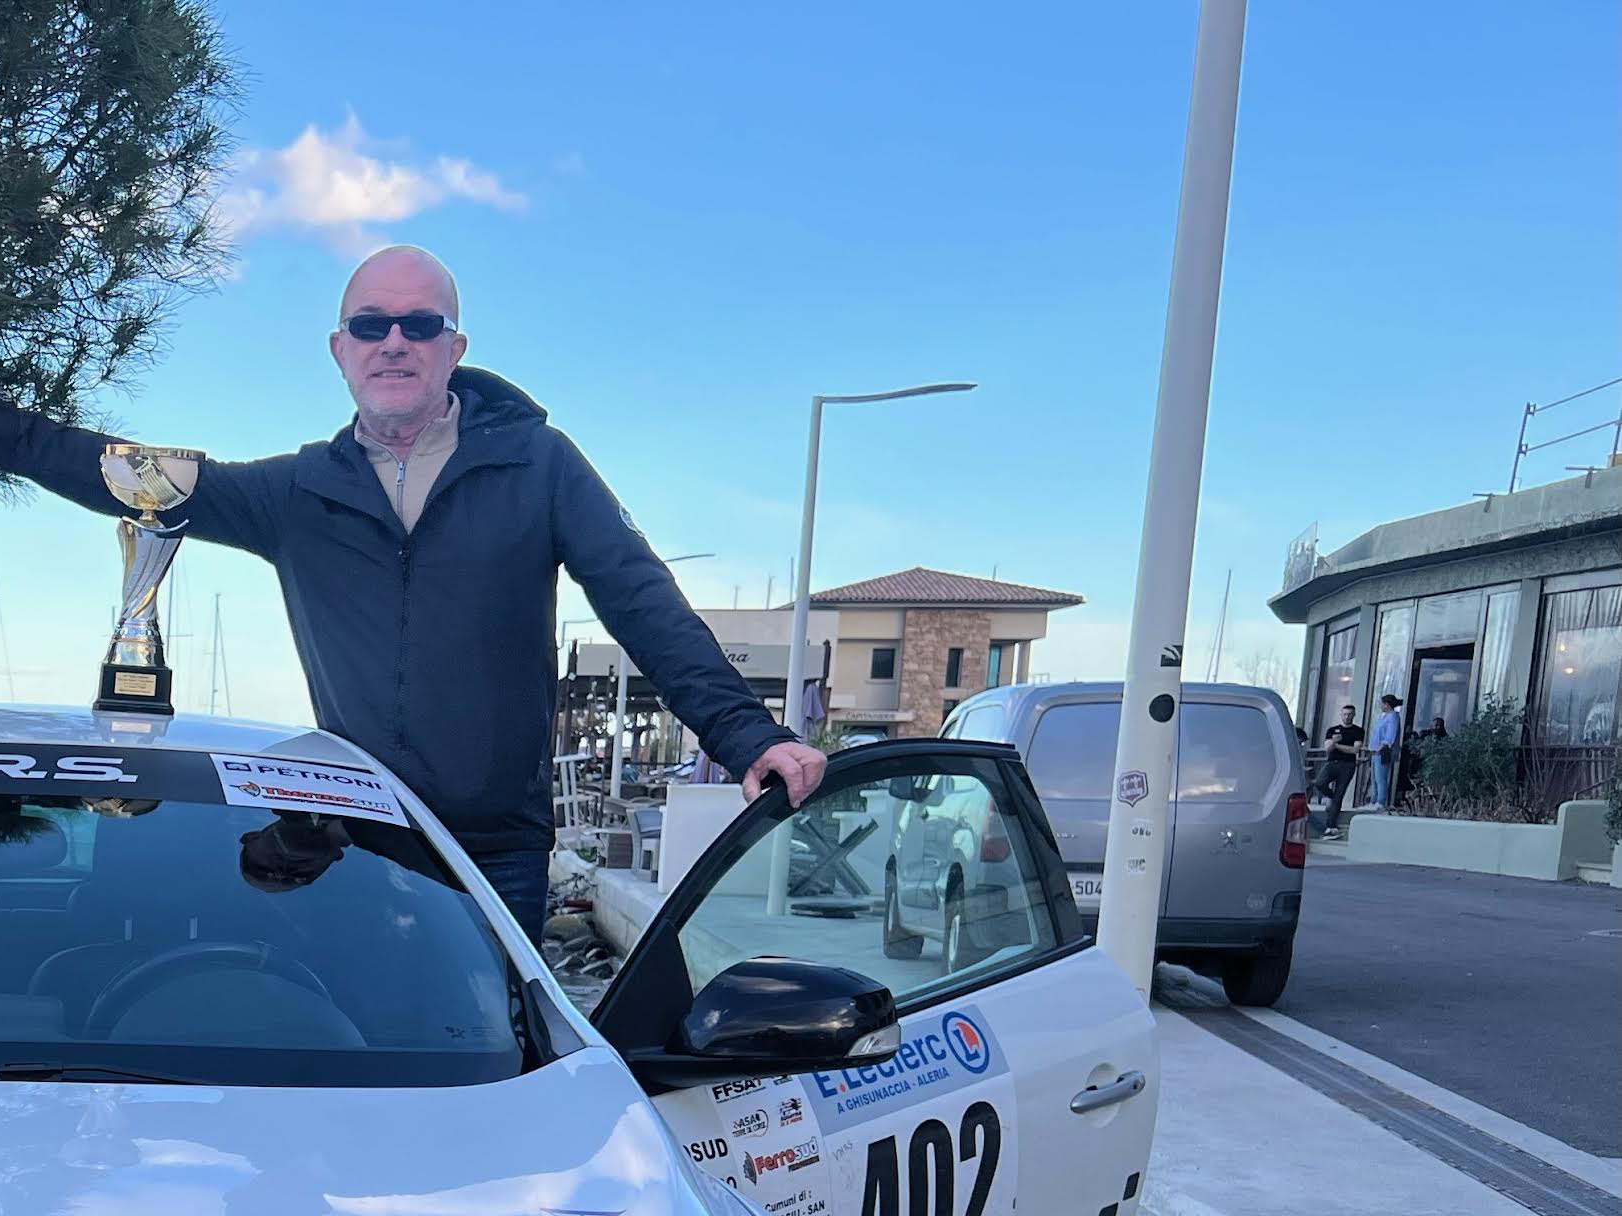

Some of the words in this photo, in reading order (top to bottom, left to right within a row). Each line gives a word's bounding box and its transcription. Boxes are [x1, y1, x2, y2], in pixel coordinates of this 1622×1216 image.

[257, 765, 382, 790] PETRONI
[837, 1102, 846, 1114] A
[846, 1080, 912, 1111] GHISUNACCIA
[918, 1067, 951, 1086] ALERIA
[685, 1138, 729, 1163] SUD
[754, 1136, 819, 1175] Ferrosud
[798, 1190, 807, 1202] di
[807, 1200, 825, 1216] SAN
